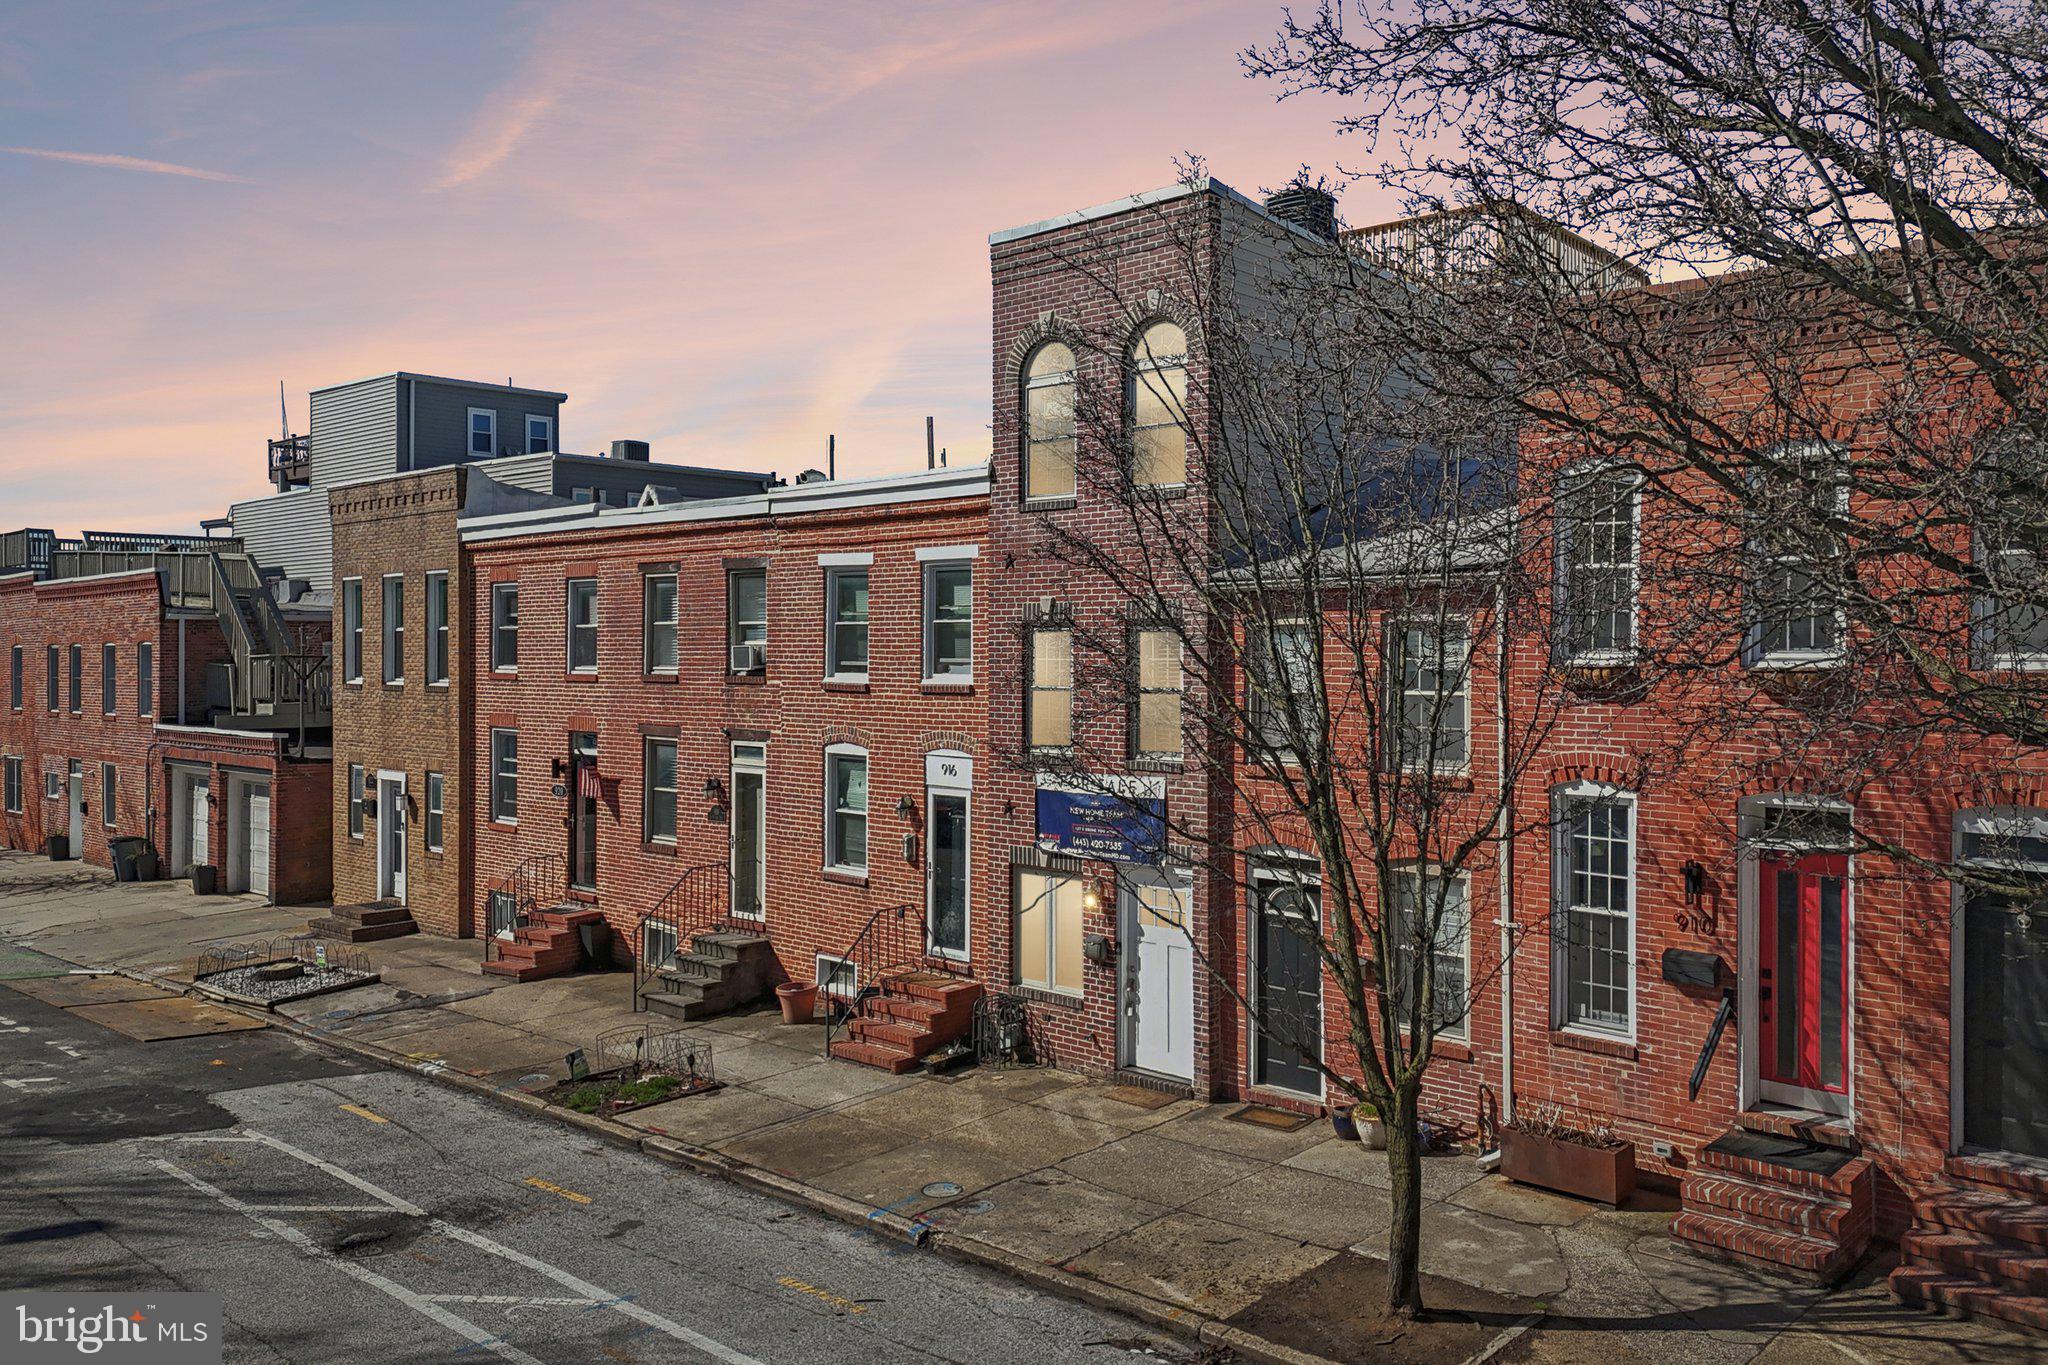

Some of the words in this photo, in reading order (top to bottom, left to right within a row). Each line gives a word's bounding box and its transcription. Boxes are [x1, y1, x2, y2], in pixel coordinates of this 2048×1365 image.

[941, 763, 957, 777] 916
[1069, 806, 1084, 815] NEW
[1085, 808, 1104, 817] HOME
[1072, 836, 1089, 847] (443)
[1673, 912, 1713, 937] 910
